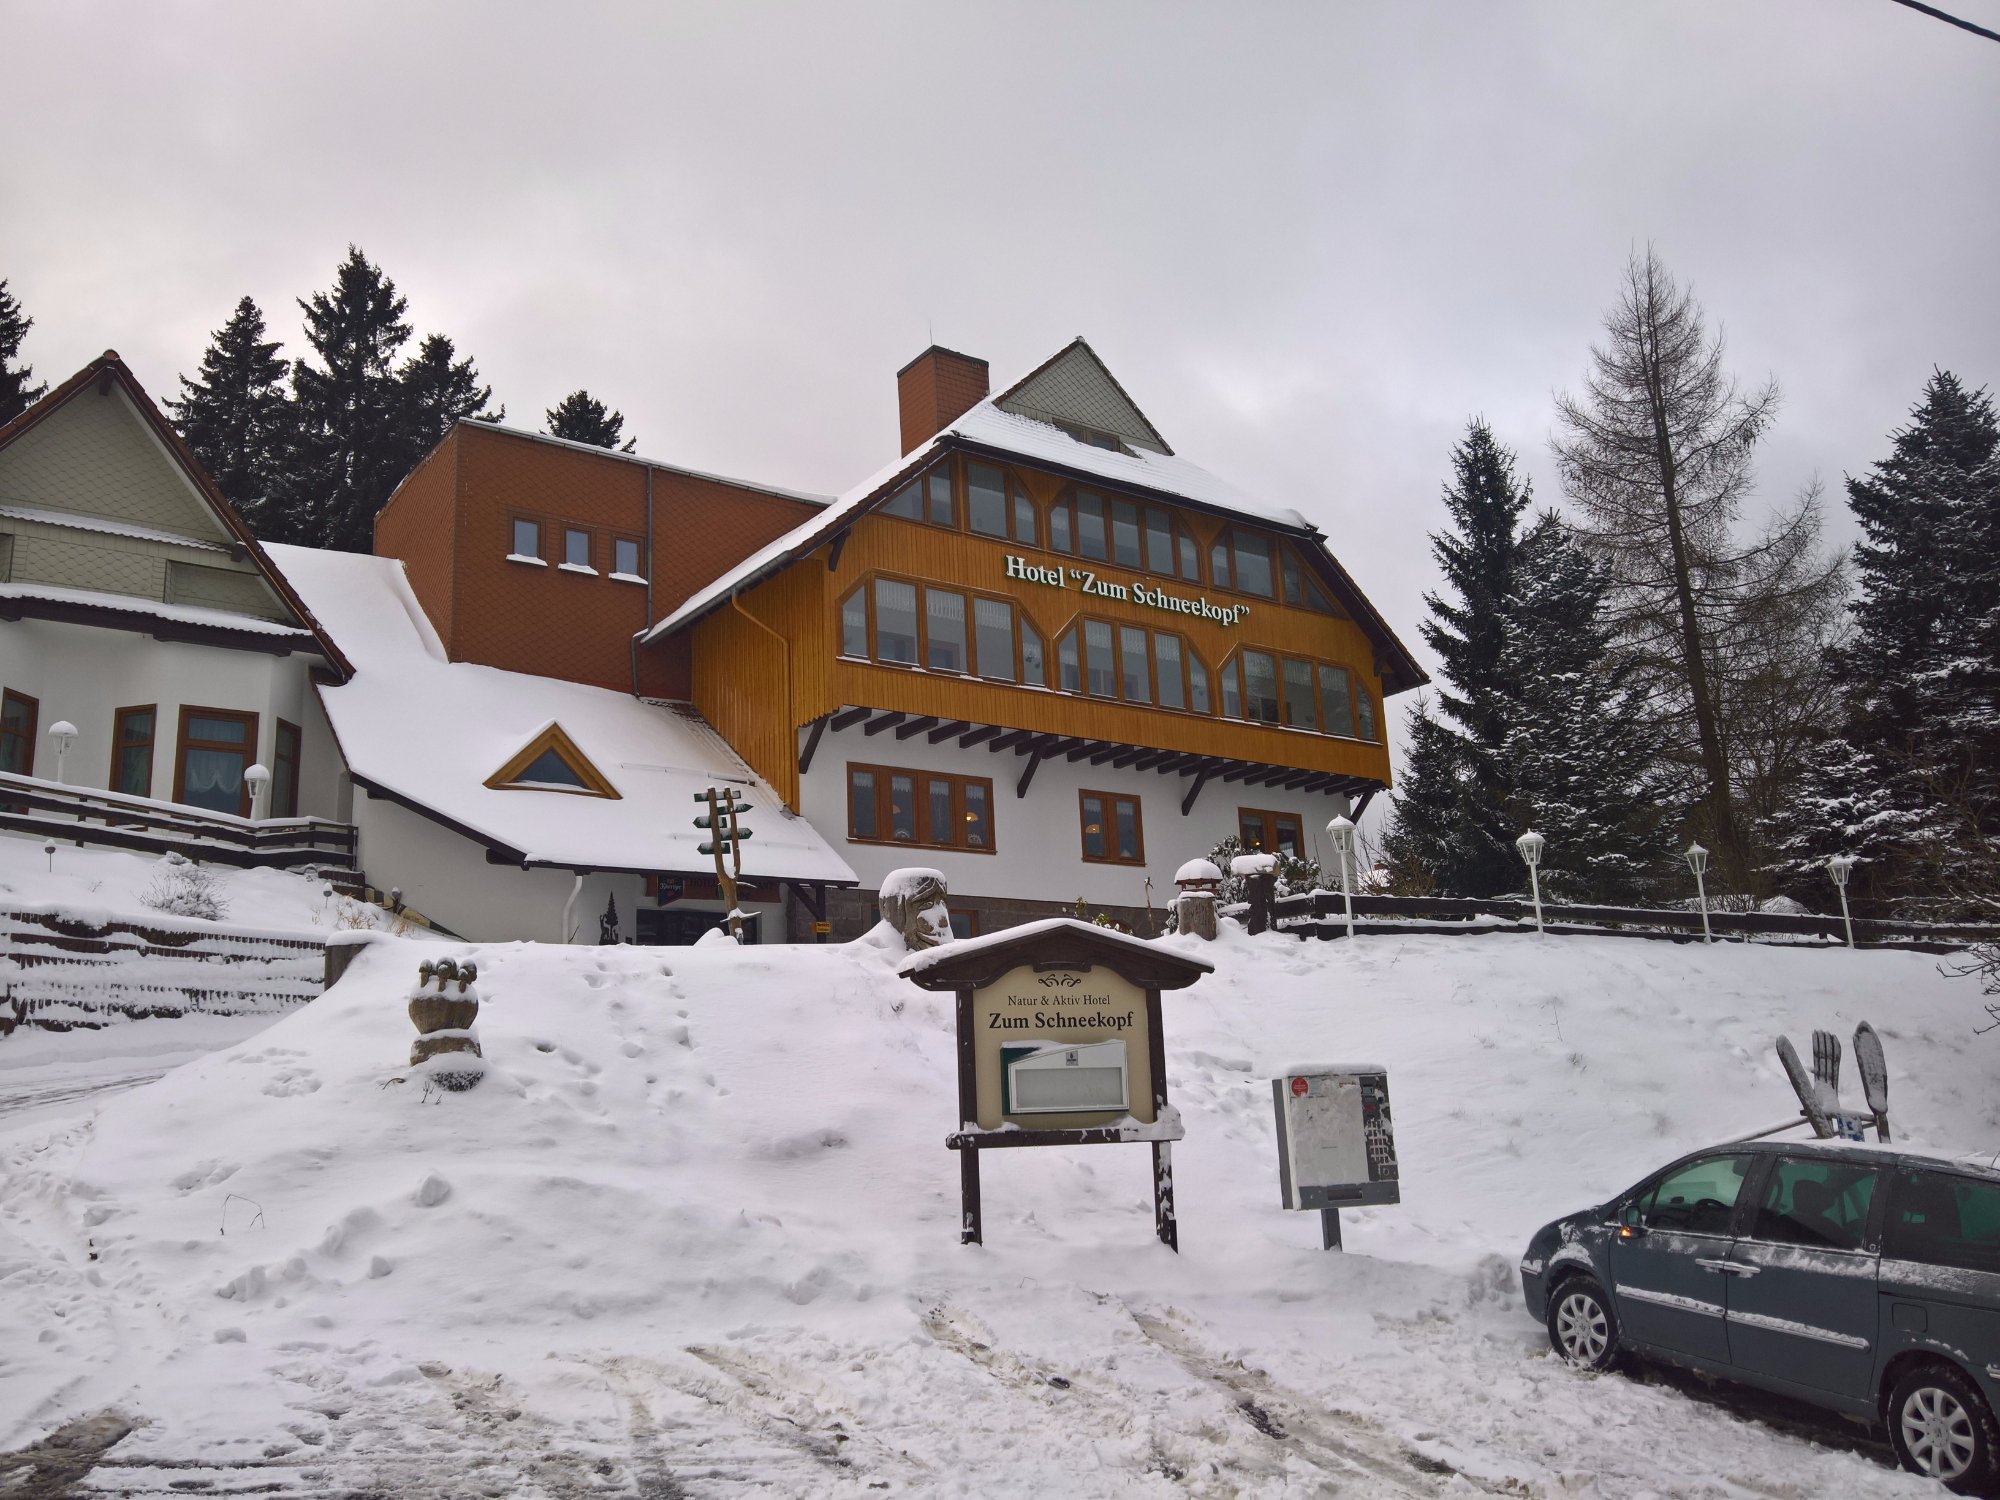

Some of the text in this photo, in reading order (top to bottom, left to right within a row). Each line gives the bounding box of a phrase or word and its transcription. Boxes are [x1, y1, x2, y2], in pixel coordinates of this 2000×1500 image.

[1005, 555, 1065, 588] Hotel
[1008, 994, 1110, 1006] Natur & Aktiv Hotel
[989, 1012, 1134, 1031] Zum Schneekopf
